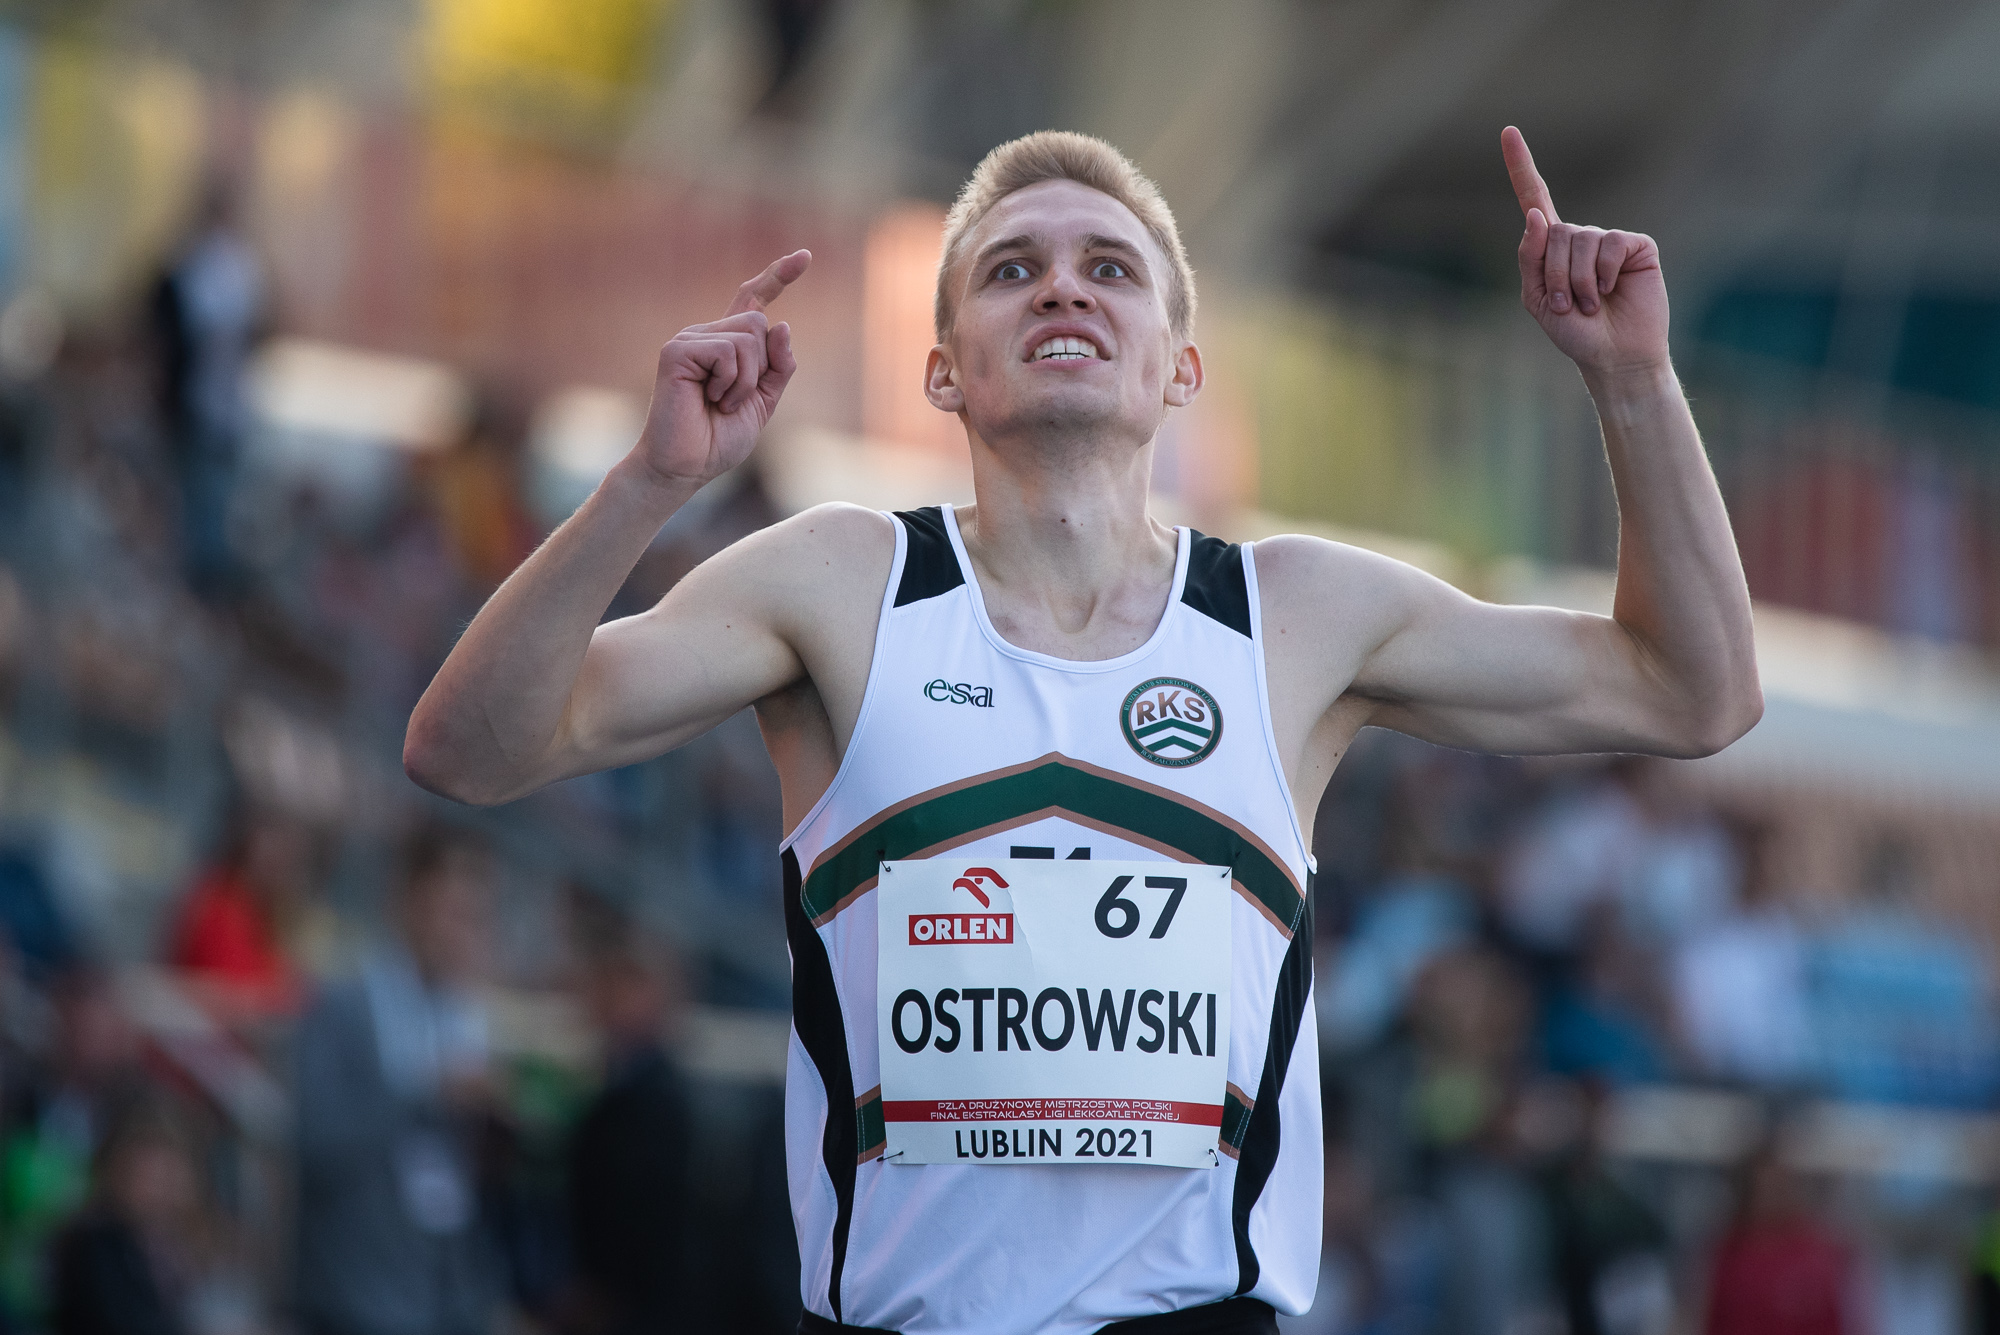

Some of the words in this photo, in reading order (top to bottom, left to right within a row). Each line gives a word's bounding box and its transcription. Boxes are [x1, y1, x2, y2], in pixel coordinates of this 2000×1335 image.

[1139, 682, 1155, 694] KLUB
[1155, 679, 1193, 690] SPORTOWY
[1136, 690, 1205, 726] RKS
[1094, 875, 1188, 939] 67
[913, 918, 1007, 941] ORLEN
[891, 987, 1217, 1057] OSTROWSKI
[930, 1112, 961, 1120] FINAŁ
[963, 1110, 1043, 1120] EKSTRAKLASY
[1045, 1110, 1065, 1118] LIGI
[1067, 1110, 1180, 1121] LEKKOATLETYCZNEJ
[937, 1102, 966, 1111] PZLA
[969, 1100, 1042, 1110] DRUŻYNOWE
[1044, 1100, 1130, 1110] MISTRZOSTWA
[1132, 1102, 1172, 1111] POLSKI
[955, 1128, 1062, 1158] LUBLIN
[1075, 1128, 1152, 1158] 2021
